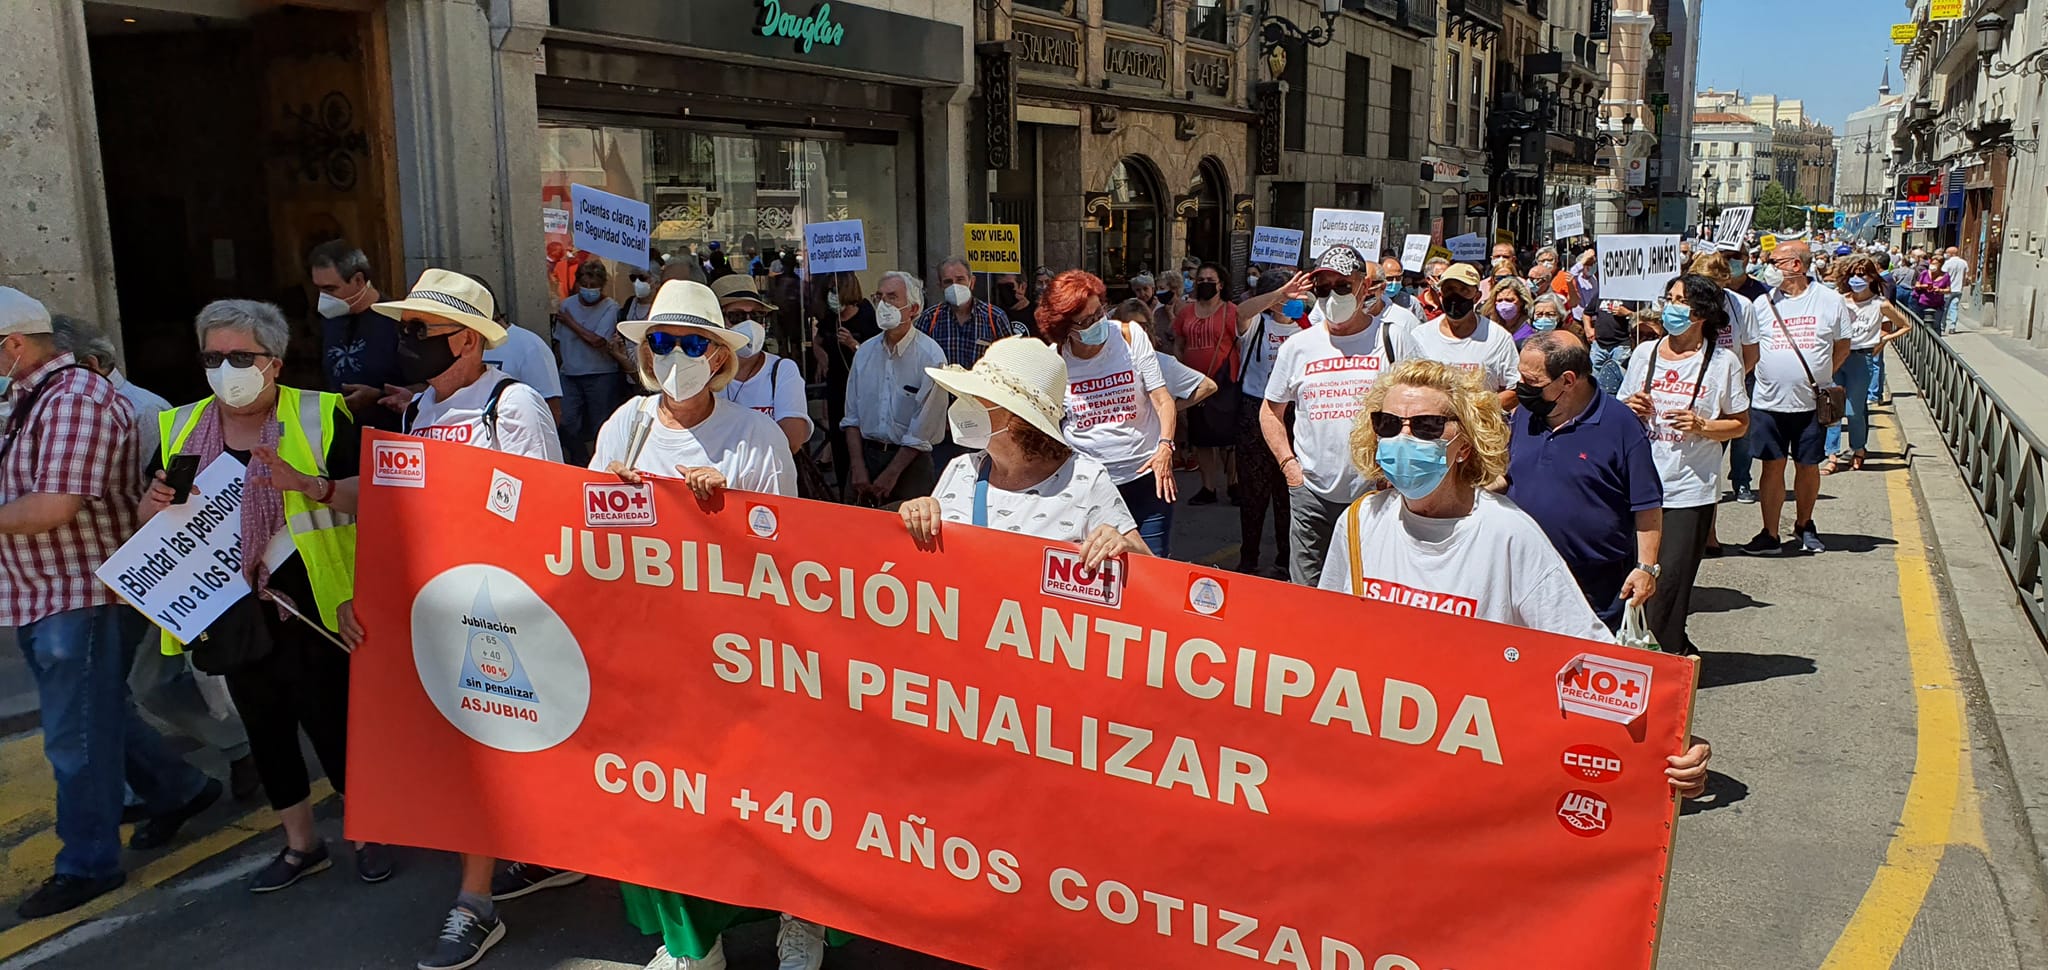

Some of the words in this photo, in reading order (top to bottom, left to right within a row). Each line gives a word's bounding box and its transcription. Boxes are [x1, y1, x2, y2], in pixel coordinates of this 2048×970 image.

[762, 0, 844, 53] Douglas
[580, 199, 610, 220] ¡Cuentas
[612, 209, 636, 230] claras,
[638, 219, 648, 233] ya,
[1319, 219, 1348, 232] ¡Cuentas
[1349, 221, 1370, 233] claras,
[575, 220, 583, 232] en
[585, 220, 620, 245] Seguridad
[621, 232, 646, 251] Social!
[971, 230, 986, 242] SOY
[988, 230, 1015, 243] VIEJO,
[1312, 237, 1320, 246] en
[1355, 238, 1377, 249] Social!
[818, 248, 841, 262] Seguridad
[968, 250, 979, 262] NO
[981, 250, 1019, 262] PENDEJO.
[1603, 249, 1646, 285] ¡EDADISMO,
[1648, 238, 1677, 274] JAMÁS!
[1306, 357, 1378, 374] ASJUBI40
[1073, 372, 1131, 393] ASJUBI40
[1303, 390, 1316, 400] SIN
[1319, 387, 1370, 398] PENALIZA
[1072, 404, 1086, 412] SIN
[1309, 409, 1360, 421] COTIZADO
[1077, 412, 1137, 429] COTIZADOS
[379, 451, 420, 469] NO+
[378, 468, 421, 476] PRECARIEDAD
[588, 490, 648, 512] NO+
[590, 512, 650, 520] PRECARIEDAD
[118, 548, 178, 606] ¡Blindar
[160, 531, 196, 559] las
[185, 477, 244, 546] pensiones
[193, 565, 230, 592] los
[1048, 555, 1116, 586] NO+
[190, 585, 208, 600] a
[1047, 580, 1115, 599] PRECARIEDAD
[169, 593, 197, 618] no
[157, 609, 182, 631] y
[461, 615, 517, 635] Jubilación
[486, 635, 497, 645] 65
[544, 525, 961, 641] JUBILACIÓN
[985, 598, 1504, 766] ANTICIPADA
[490, 651, 501, 660] 40
[481, 664, 497, 675] 100
[498, 667, 508, 678] %
[466, 678, 482, 689] sin
[485, 682, 534, 699] penalizar
[1563, 667, 1640, 698] NO+
[1562, 687, 1638, 710] PRECARIEDAD
[461, 696, 538, 723] ASJUBI40
[712, 633, 824, 700] SIN
[847, 658, 1270, 815] PENALIZAR
[1563, 752, 1621, 772] CCOO
[1563, 792, 1606, 821] UGT
[593, 751, 708, 815] CON
[731, 787, 834, 841] +40
[856, 812, 1022, 894] AÑOS
